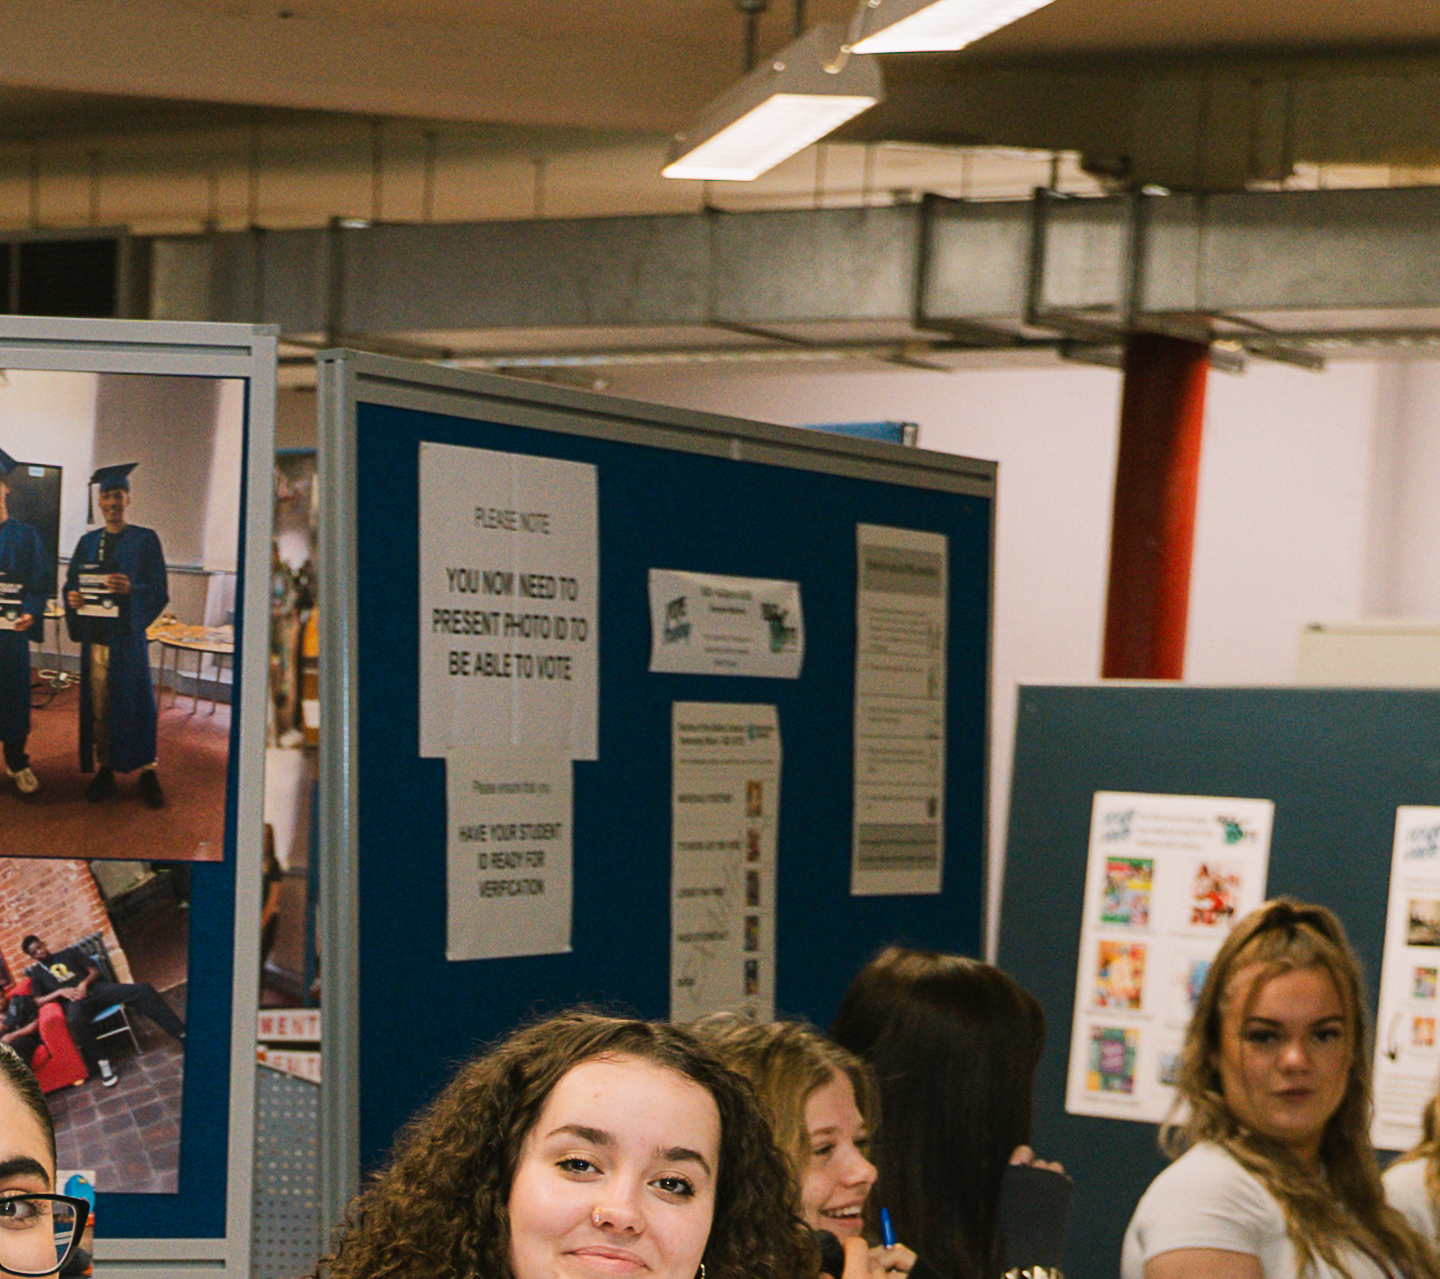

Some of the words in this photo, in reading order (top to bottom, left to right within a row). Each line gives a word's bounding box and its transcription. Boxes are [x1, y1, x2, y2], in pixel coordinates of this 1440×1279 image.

[446, 567, 479, 594] YOU
[482, 571, 514, 597] NOW
[520, 574, 555, 600] NEED
[559, 577, 579, 602] TO
[432, 609, 500, 636] PRESENT
[503, 613, 551, 639] PHOTO
[554, 616, 568, 640] ID
[571, 617, 589, 642] TO
[449, 651, 471, 676] BE
[474, 652, 512, 678] ABLE
[514, 653, 534, 679] TO
[537, 655, 572, 681] VOTE
